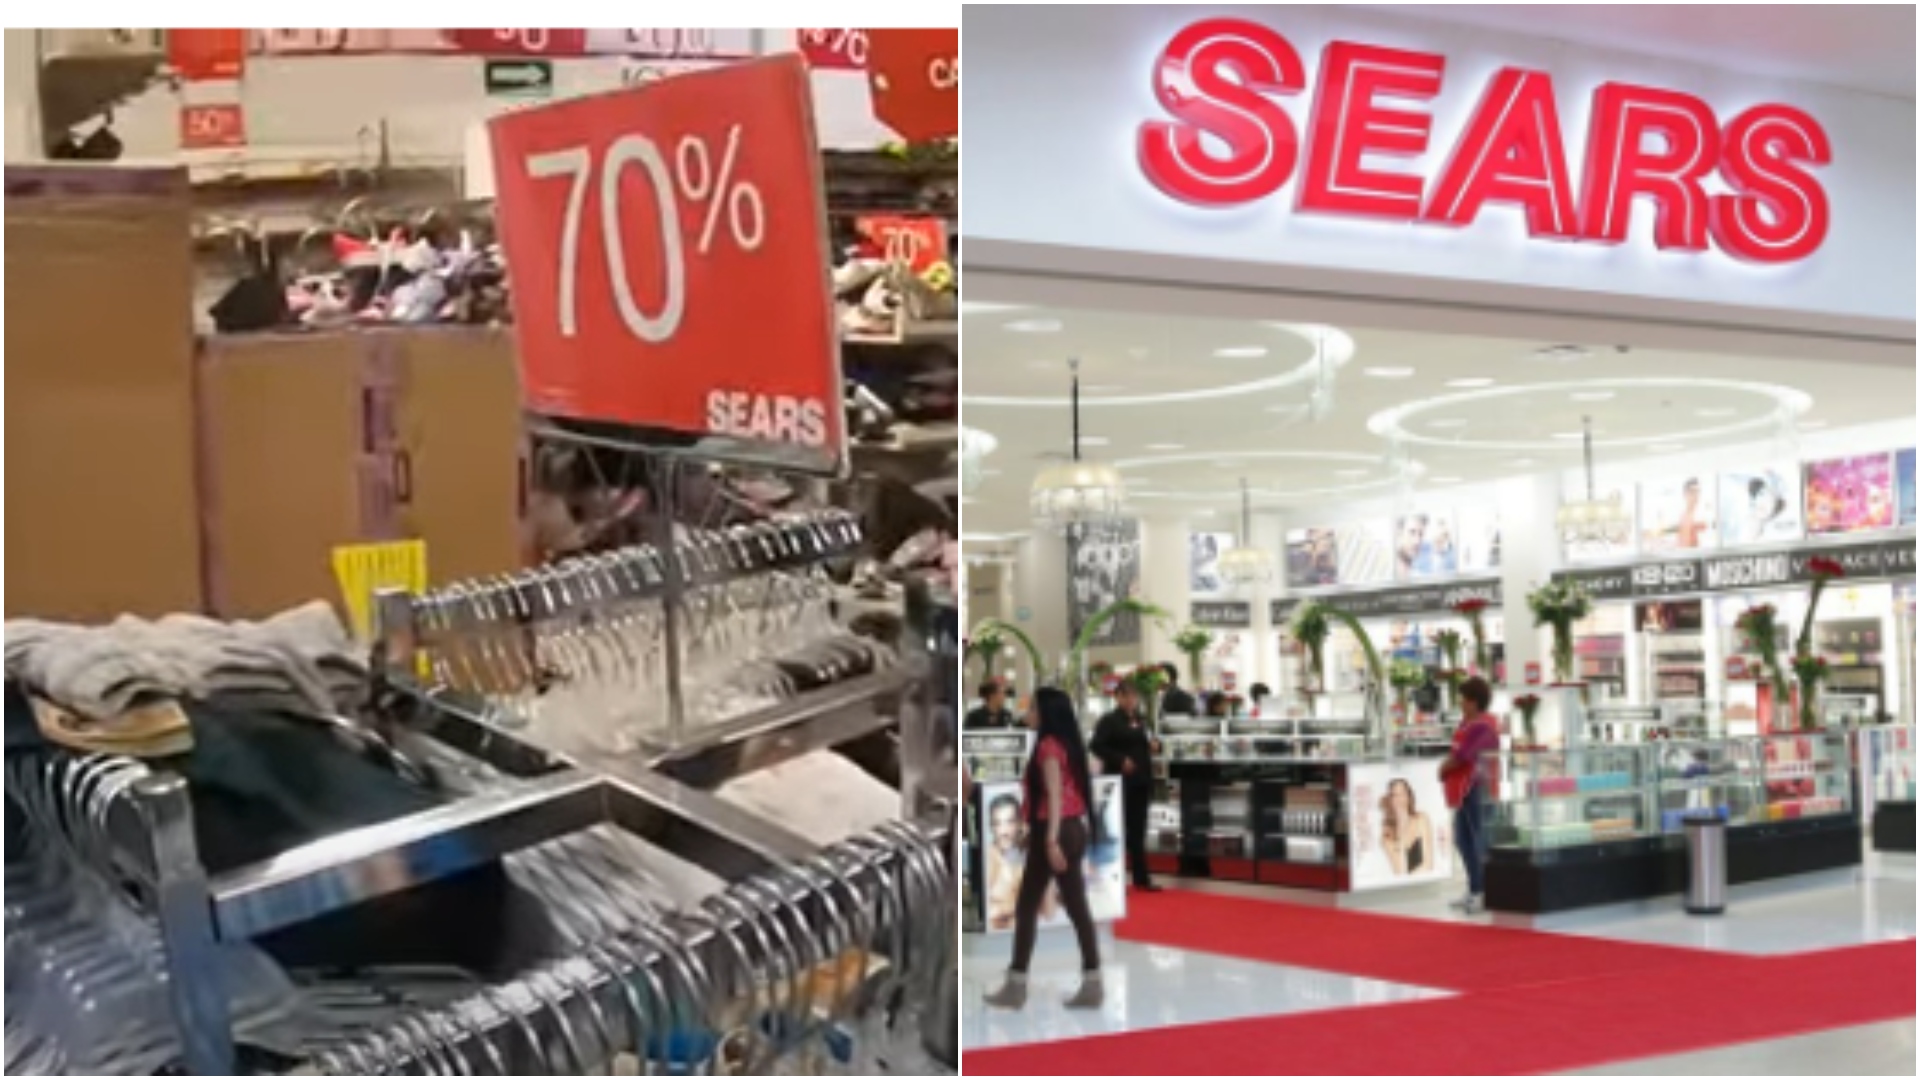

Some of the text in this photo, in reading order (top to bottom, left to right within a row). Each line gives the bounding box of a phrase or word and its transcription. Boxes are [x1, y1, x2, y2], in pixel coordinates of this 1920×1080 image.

[1136, 18, 1831, 264] SEARS
[525, 124, 765, 341] 70%
[706, 390, 826, 447] SEARS
[1883, 547, 1917, 567] VE
